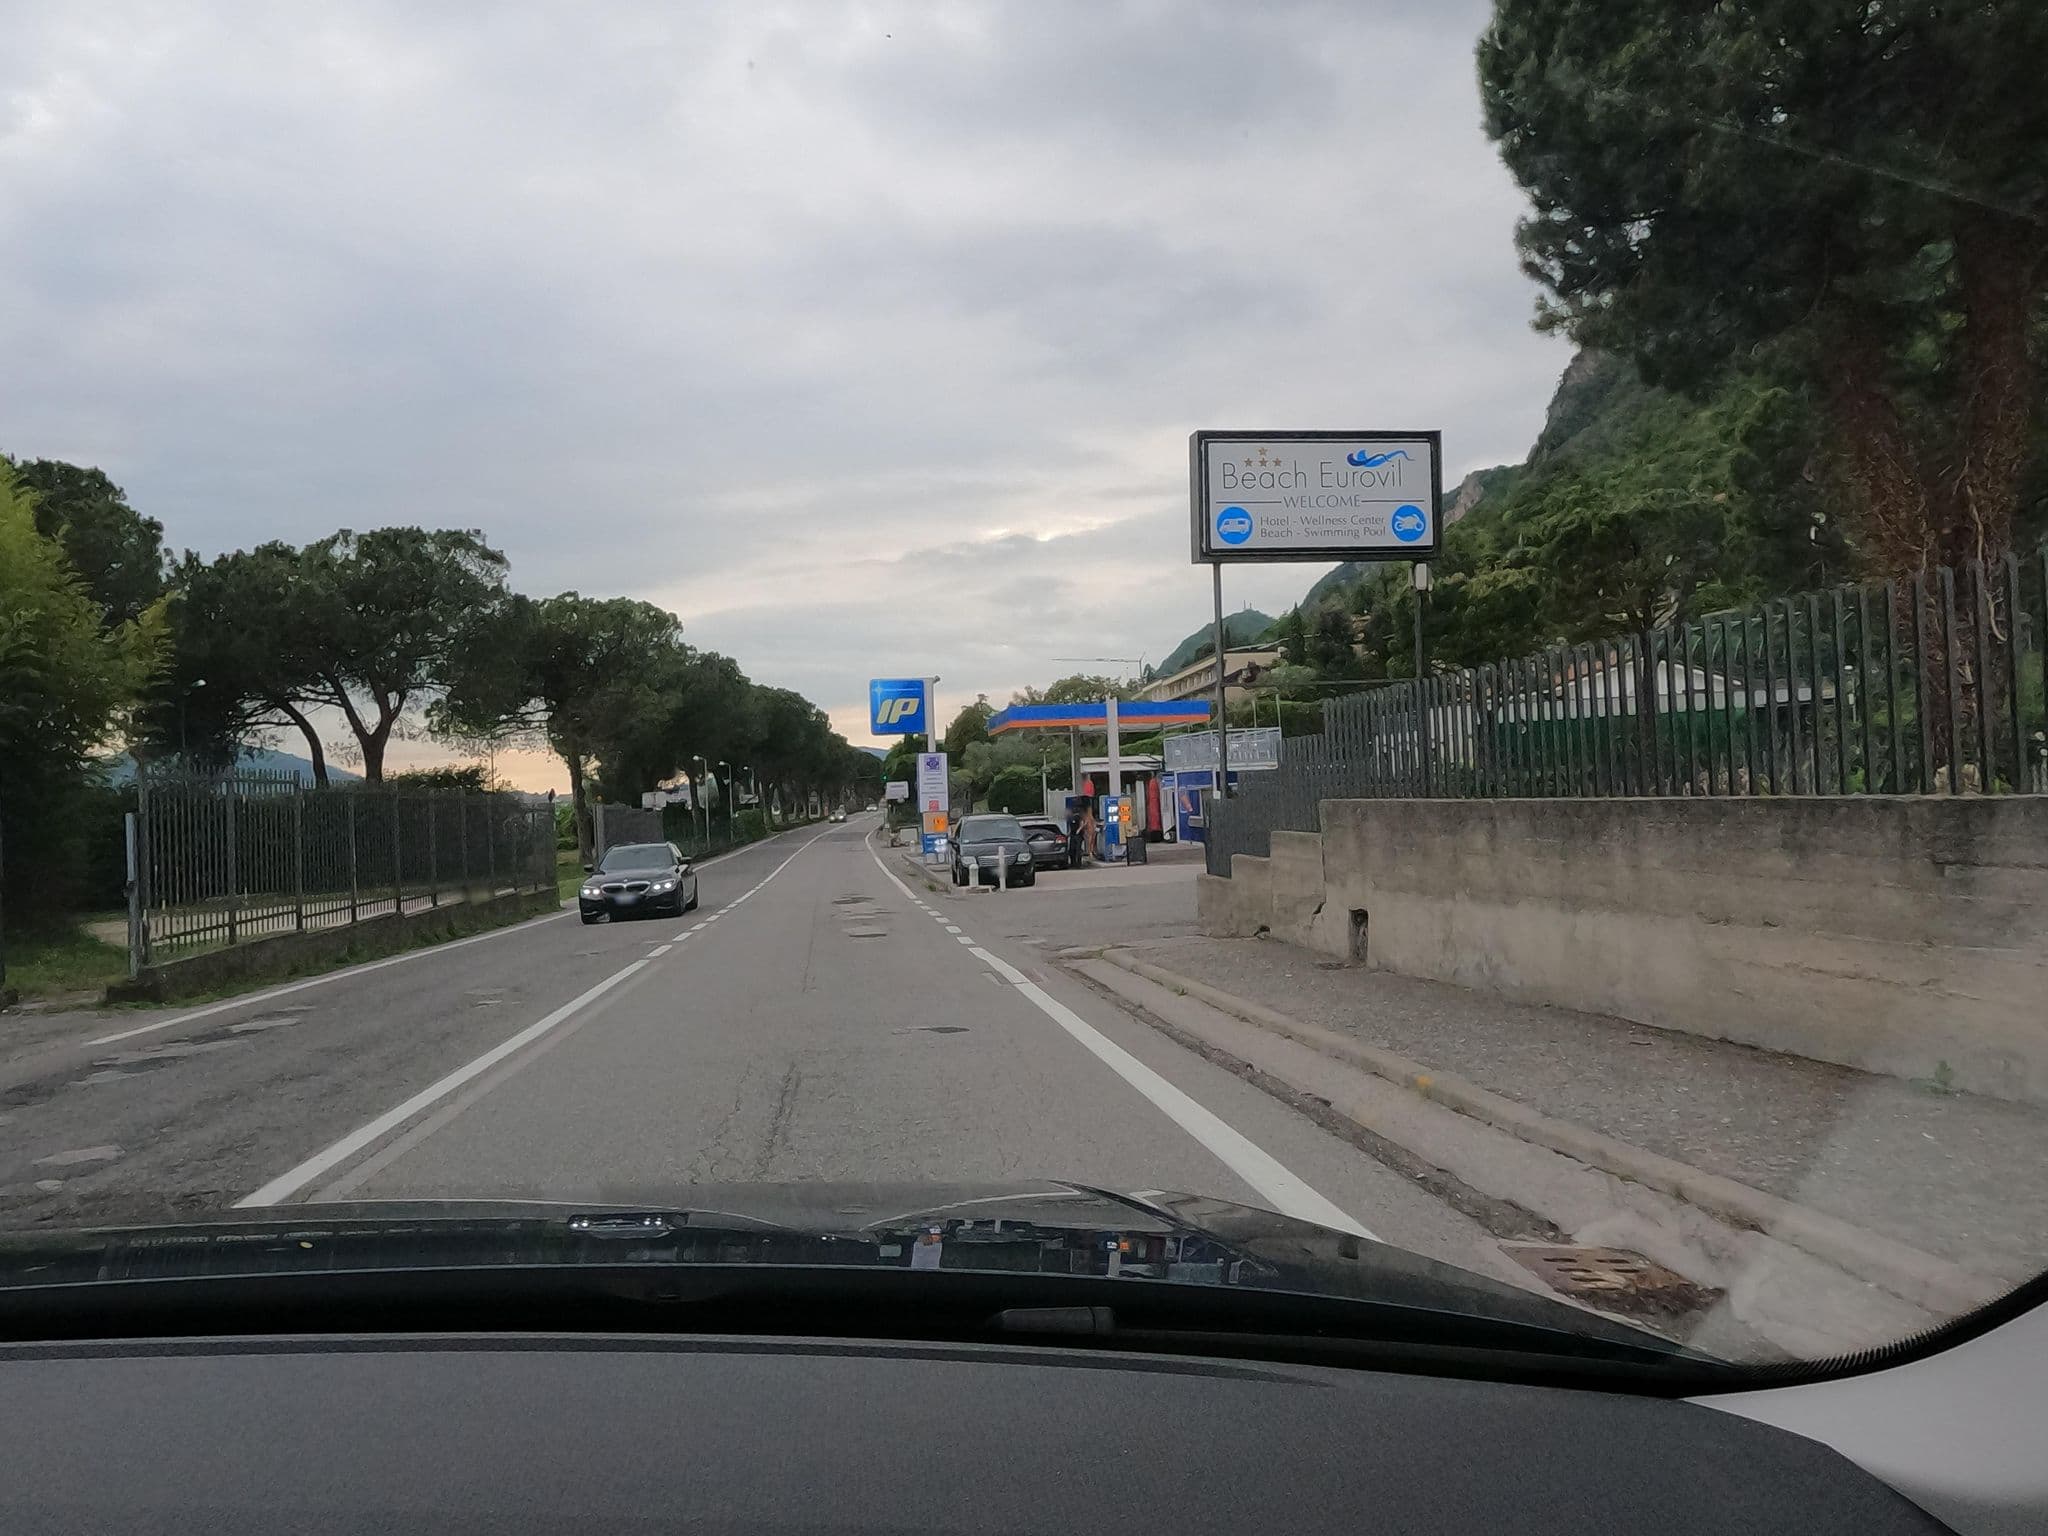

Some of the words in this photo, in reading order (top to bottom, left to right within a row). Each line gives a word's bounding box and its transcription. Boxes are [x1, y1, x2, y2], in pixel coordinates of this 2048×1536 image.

[1222, 460, 1307, 489] Beach
[1320, 459, 1402, 488] Eurovil
[1282, 494, 1361, 509] WELCOME
[1260, 515, 1290, 526] Hotel
[1299, 515, 1348, 526] Wellness
[1350, 514, 1385, 526] Center
[1260, 526, 1293, 538] Beach
[1303, 526, 1360, 539] Swimming
[1362, 526, 1386, 537] Pool
